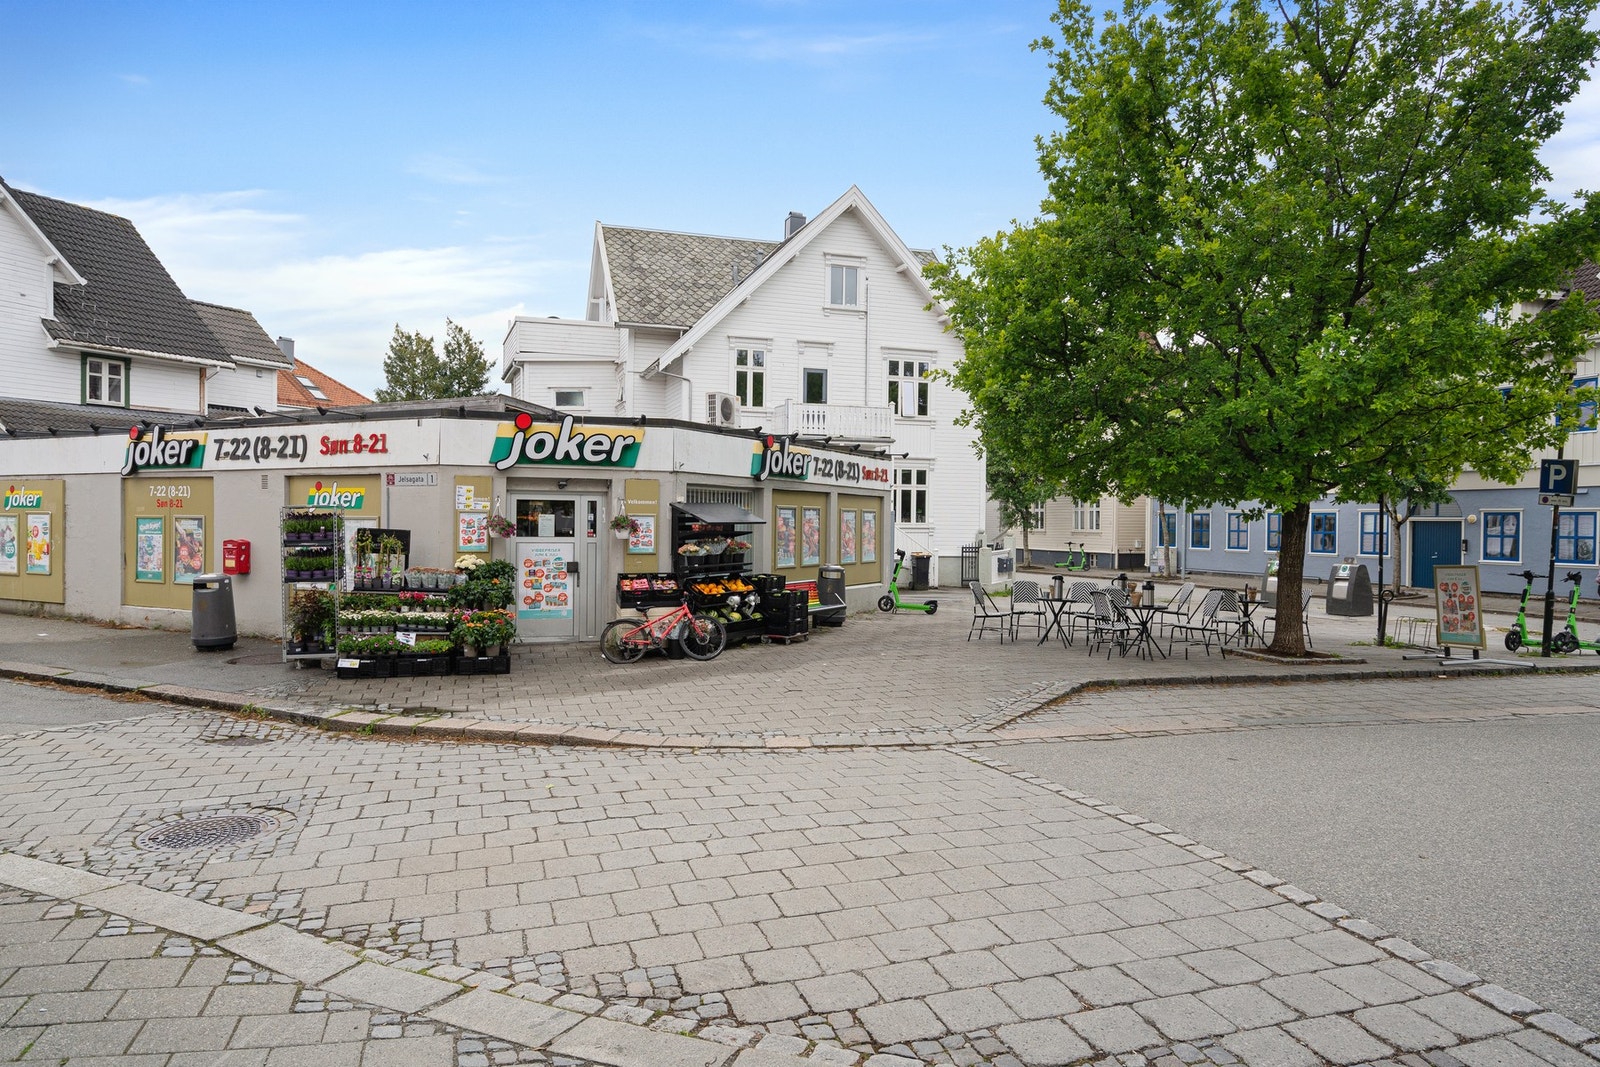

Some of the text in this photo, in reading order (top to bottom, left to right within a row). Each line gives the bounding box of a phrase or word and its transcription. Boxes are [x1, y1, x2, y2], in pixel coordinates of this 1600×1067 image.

[121, 424, 197, 476] joker
[319, 433, 388, 456] Søn 8-21
[494, 412, 636, 471] joker
[757, 435, 813, 480] joker
[398, 474, 434, 484] Jelsagata 1
[1548, 464, 1567, 490] P
[5, 485, 40, 511] joker
[149, 485, 191, 498] 7-22 (8-21)
[156, 499, 183, 508] Søn 8-21
[308, 481, 362, 516] joker
